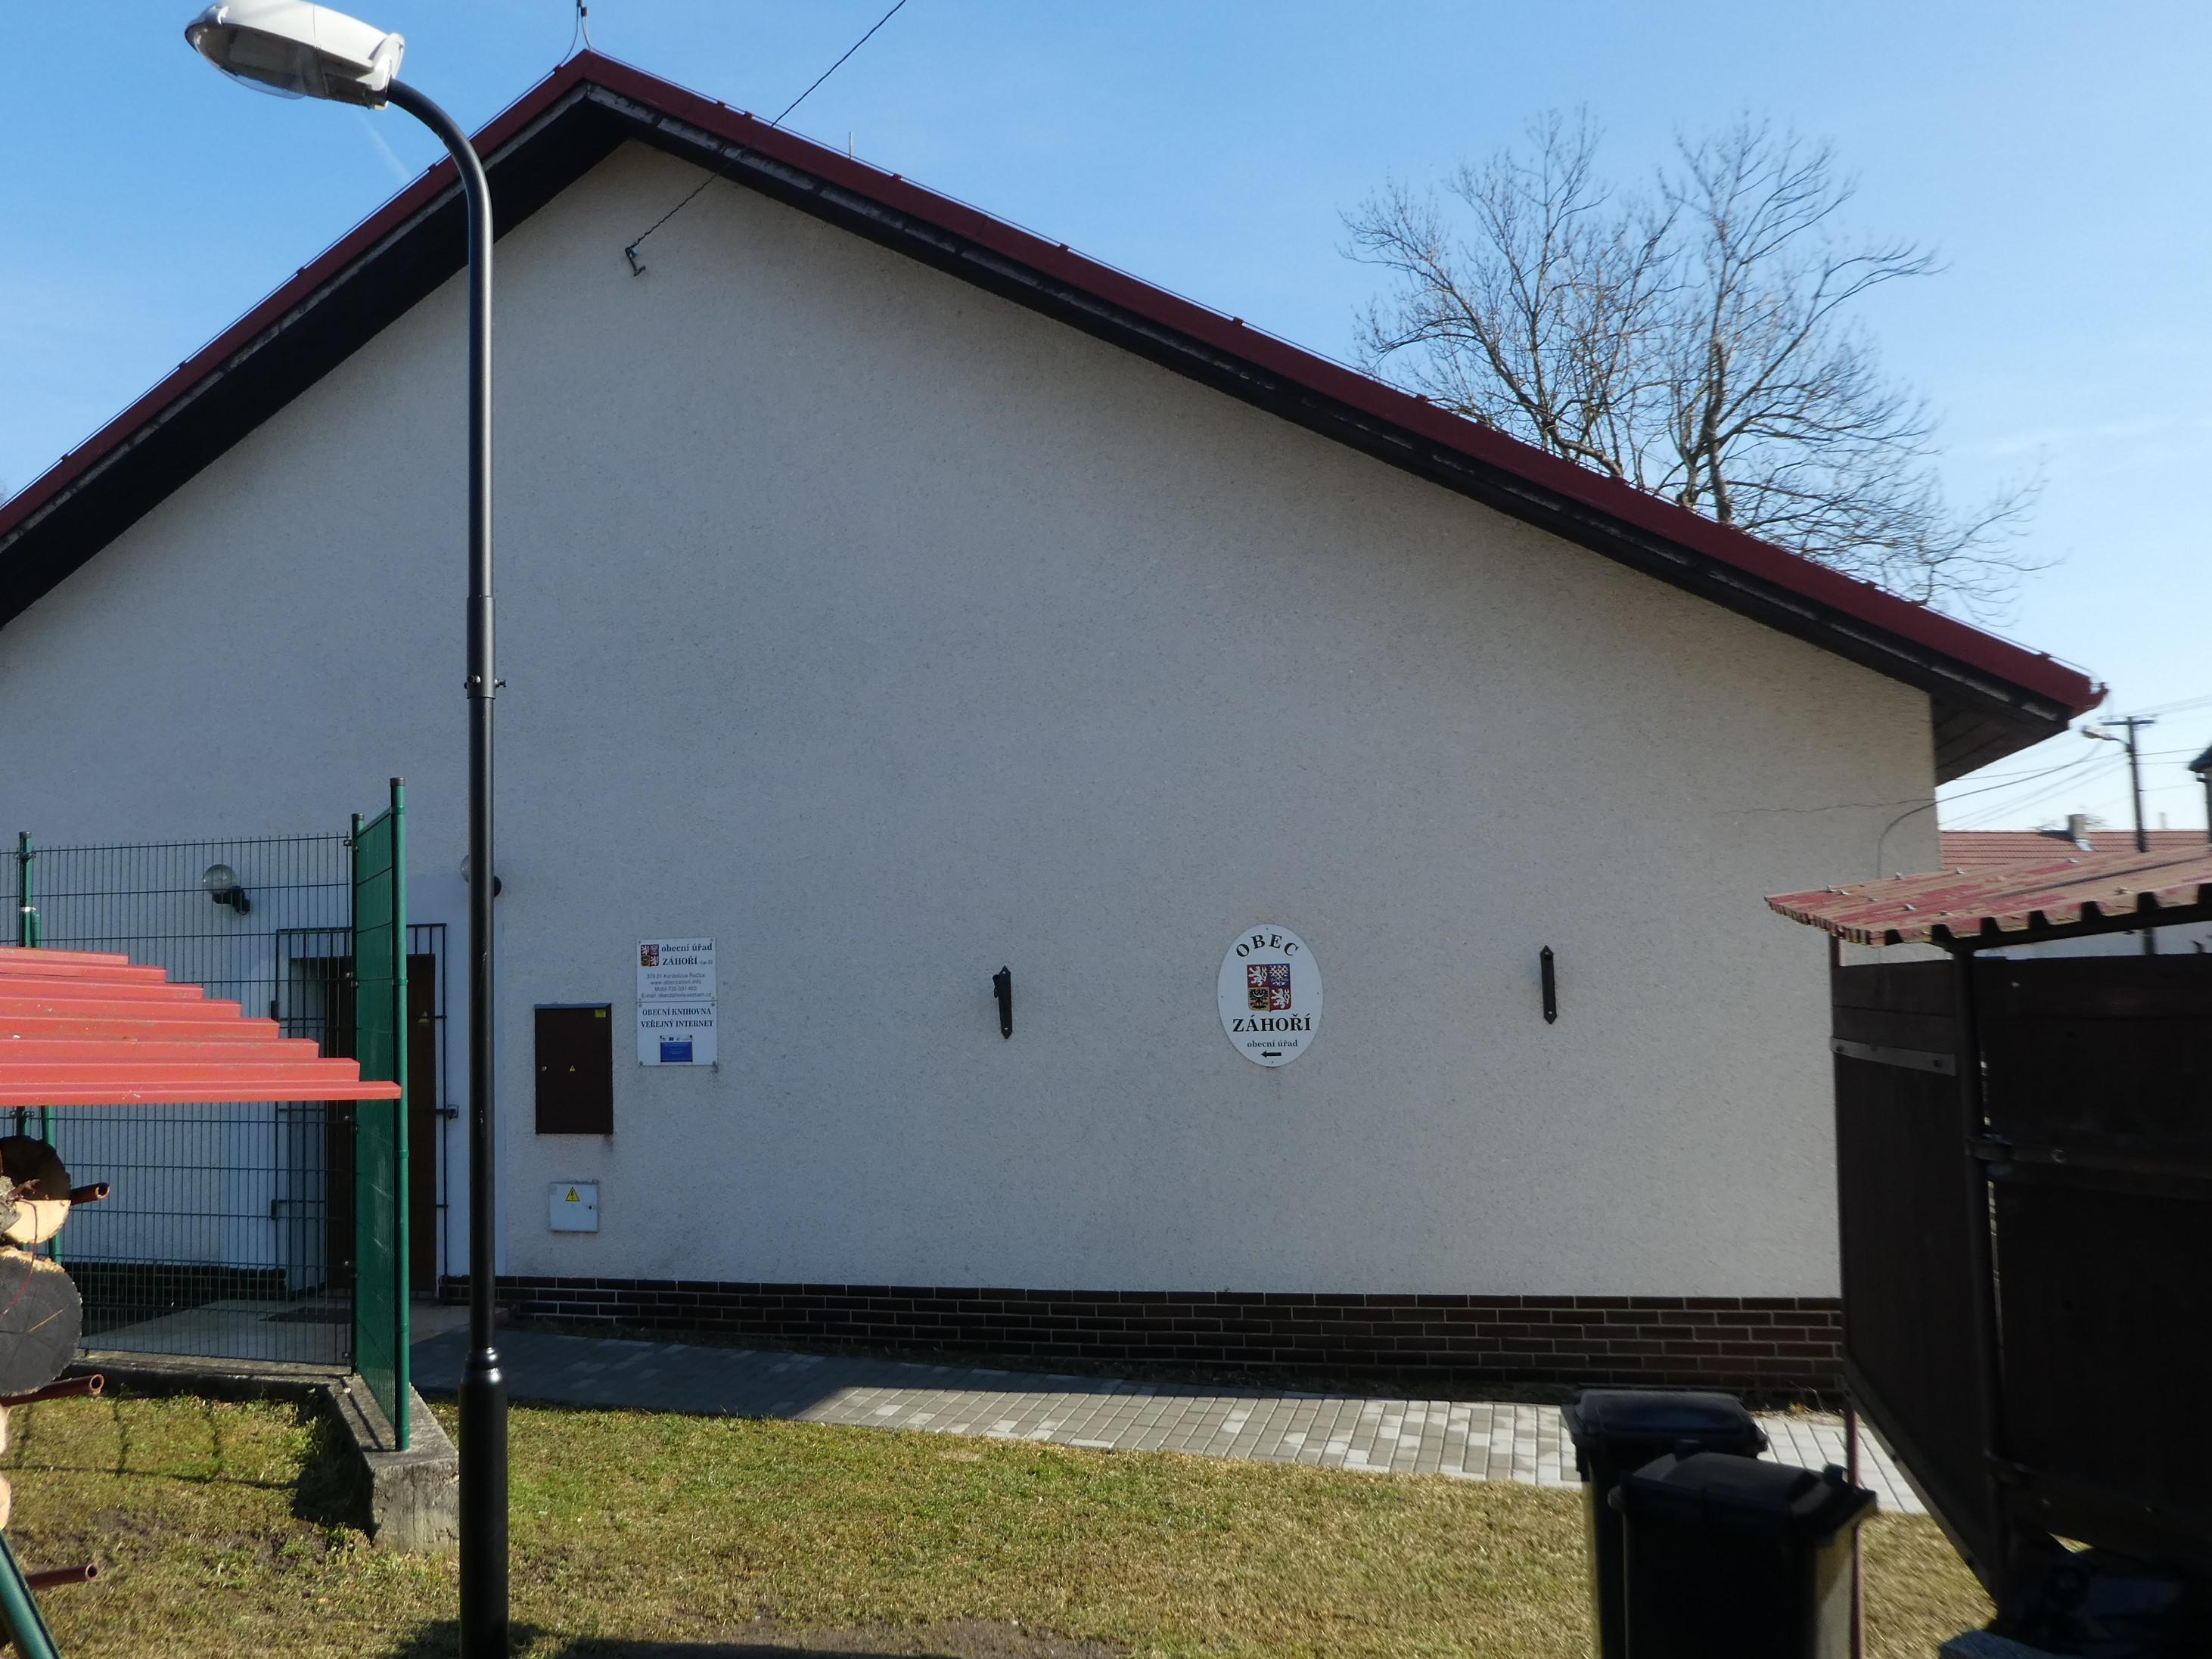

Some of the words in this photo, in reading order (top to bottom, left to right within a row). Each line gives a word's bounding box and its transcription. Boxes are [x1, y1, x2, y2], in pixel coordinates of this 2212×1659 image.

[661, 943, 689, 952] obecní
[692, 943, 713, 951] úřad
[1236, 934, 1299, 957] OBEC
[663, 955, 697, 965] ZÁHOŘÍ
[642, 1007, 670, 1016] OBECNÍ
[641, 1018, 674, 1028] VEŘEJNÝ
[676, 1019, 714, 1027] INTERNET
[1232, 1013, 1312, 1033] ZÁHOŘÍ
